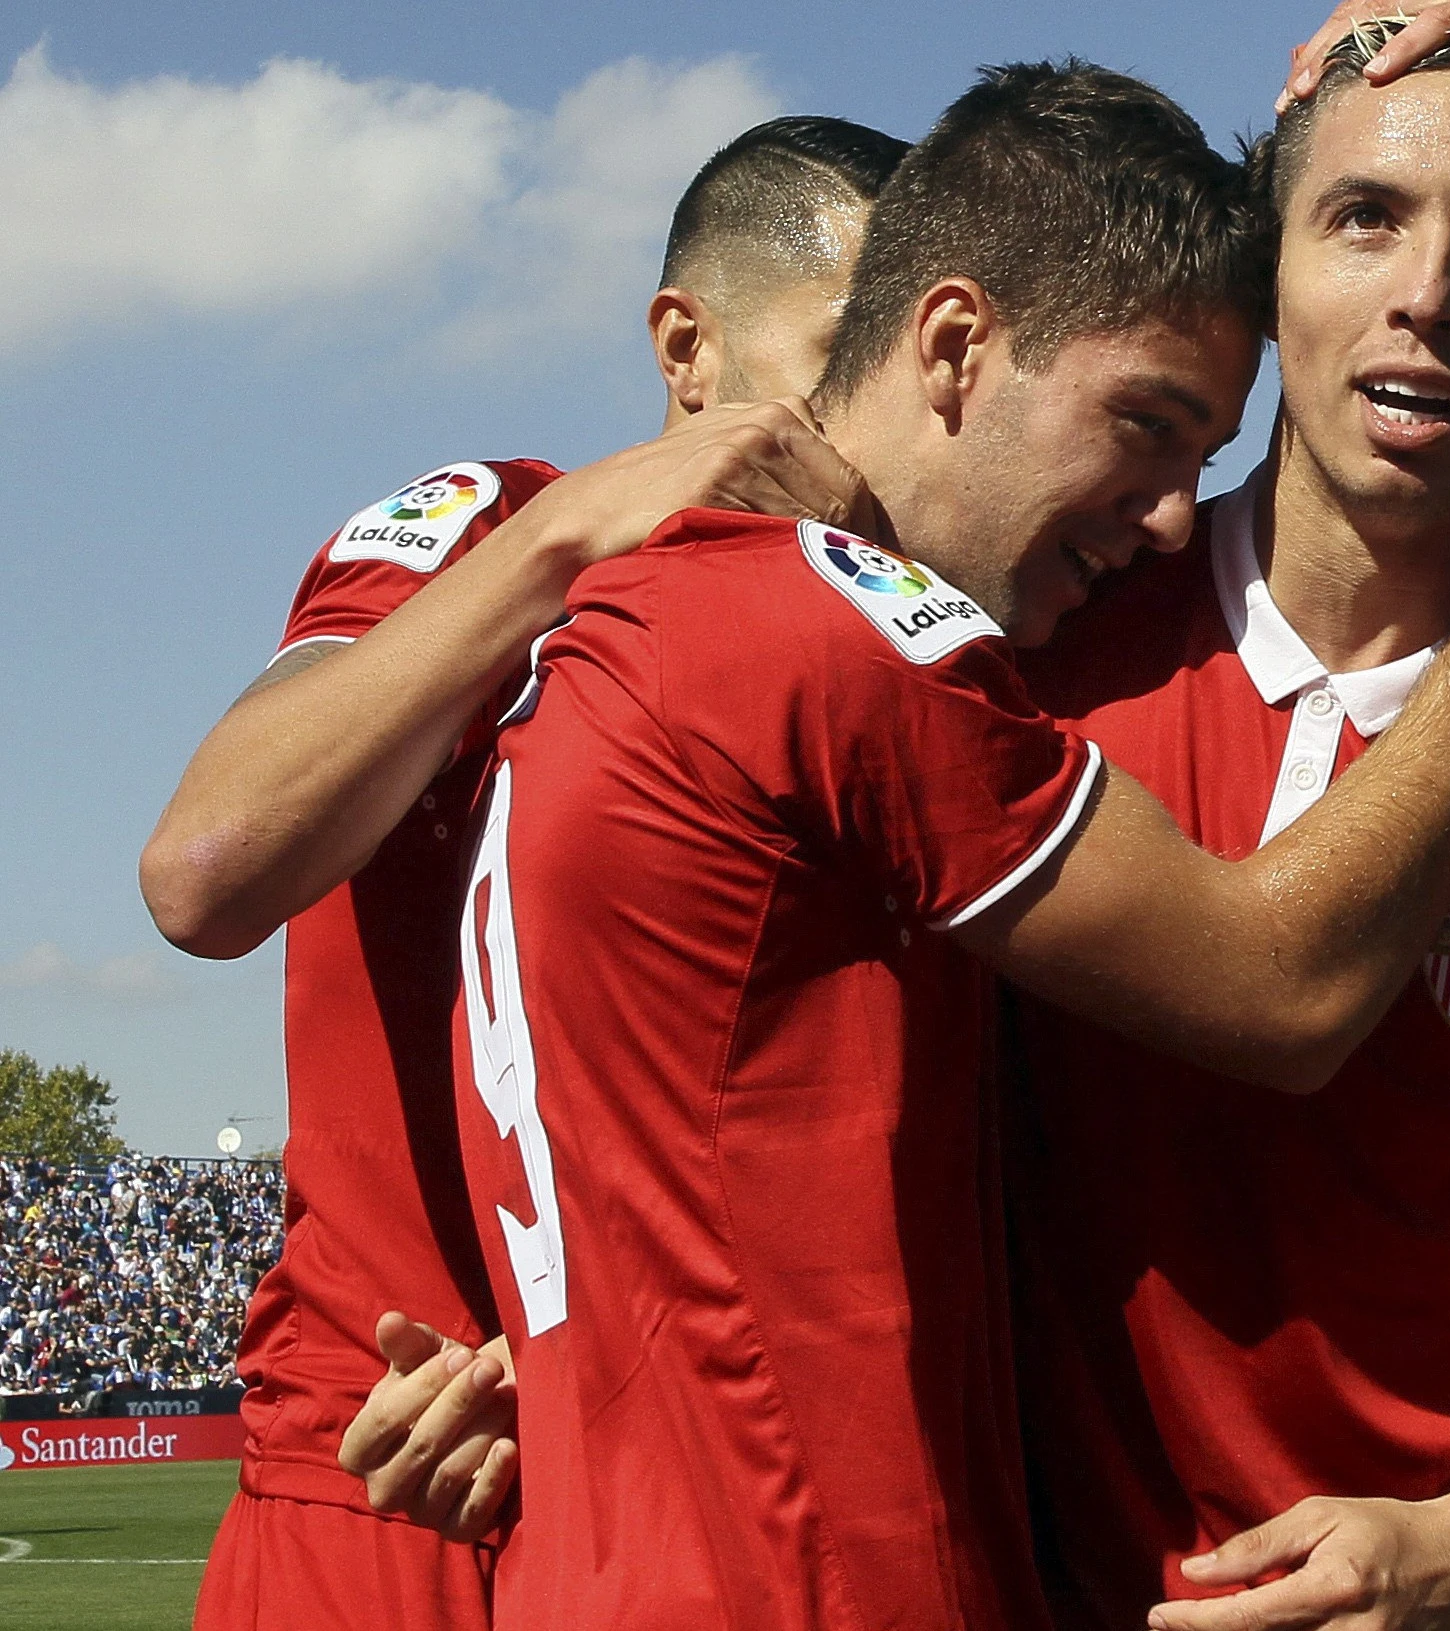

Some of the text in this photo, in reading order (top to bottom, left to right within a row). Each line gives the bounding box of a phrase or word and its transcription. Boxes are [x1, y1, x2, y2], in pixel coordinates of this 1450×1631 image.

[346, 525, 439, 551] LaLiga
[892, 597, 981, 638] LaLiga
[460, 758, 568, 1338] 9
[21, 1421, 177, 1464] Santander
